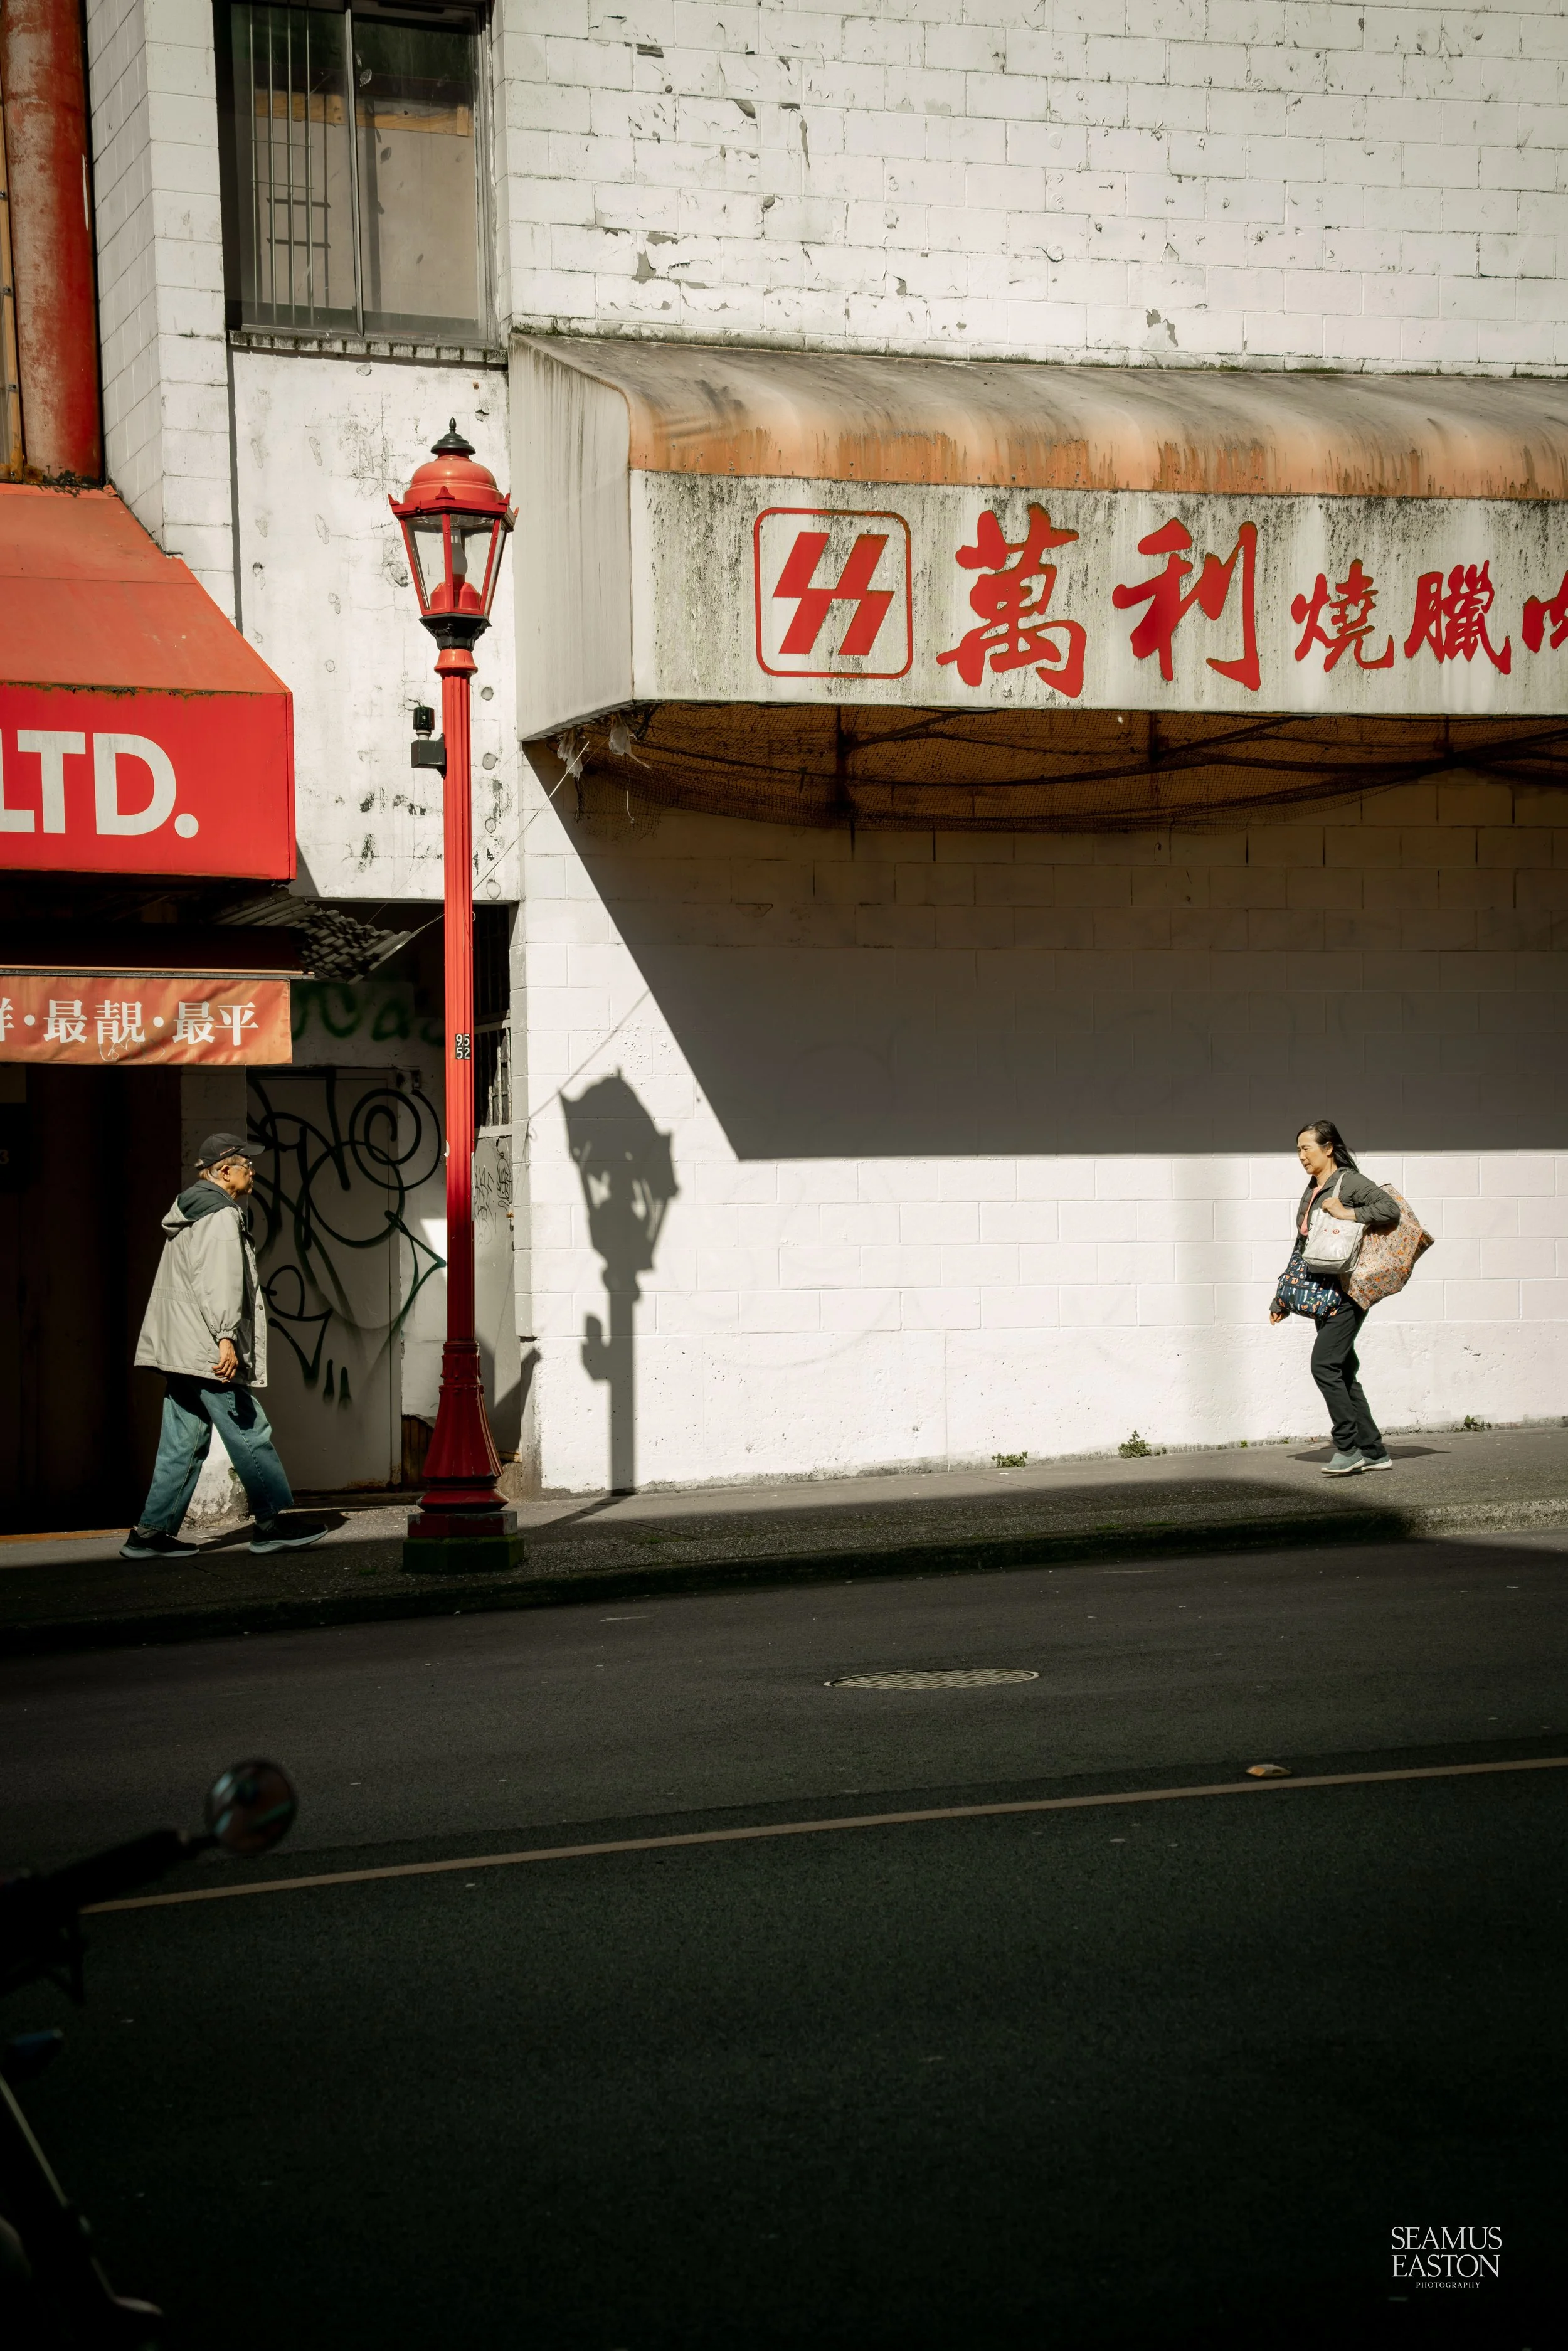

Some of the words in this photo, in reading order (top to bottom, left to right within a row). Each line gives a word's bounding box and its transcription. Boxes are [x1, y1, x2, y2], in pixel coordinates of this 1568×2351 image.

[0, 728, 199, 839] LTD.
[456, 1034, 470, 1046] 95
[457, 1047, 470, 1059] 52
